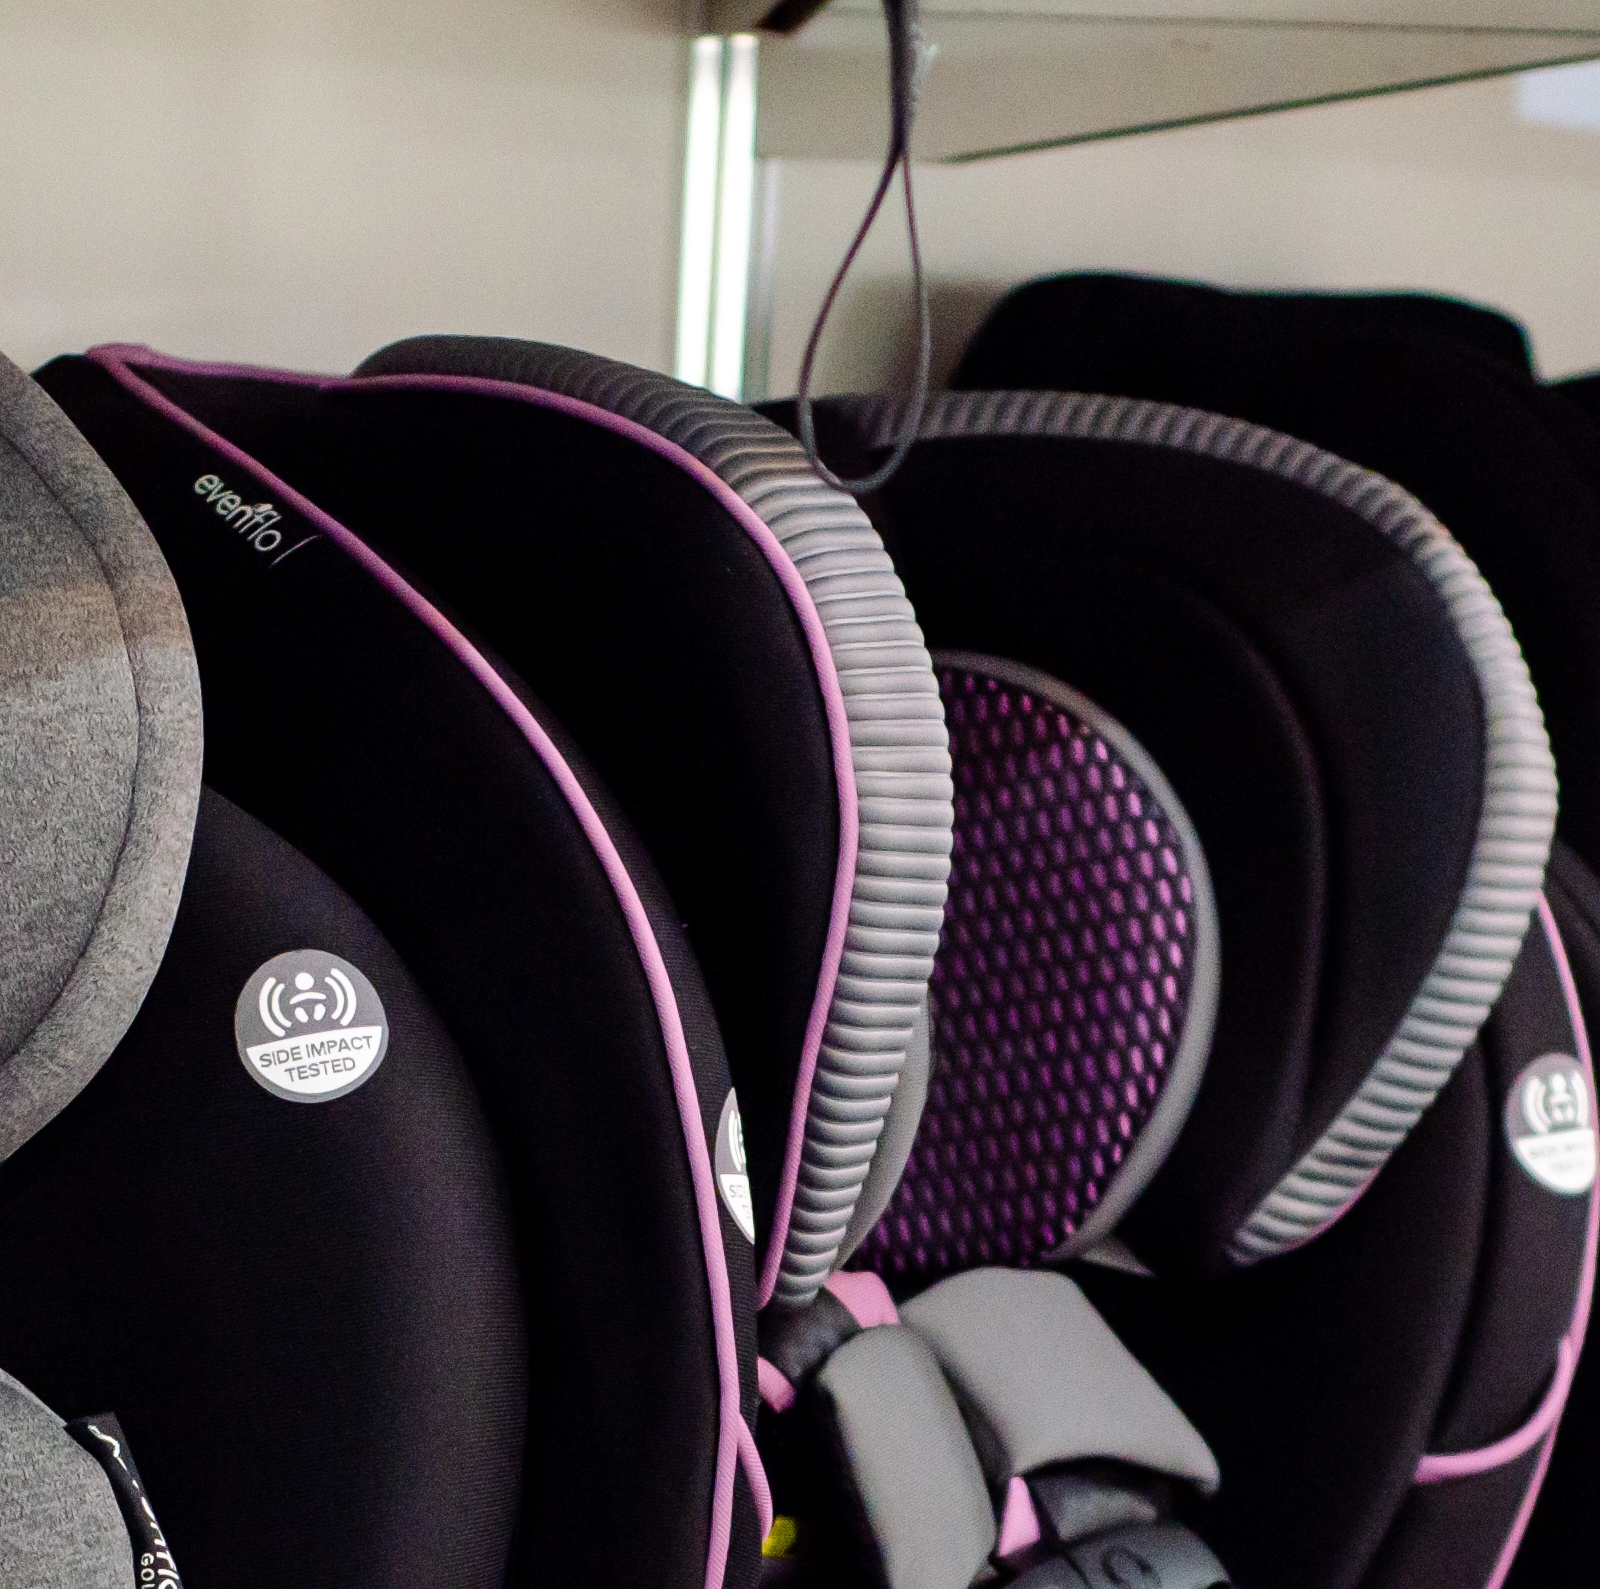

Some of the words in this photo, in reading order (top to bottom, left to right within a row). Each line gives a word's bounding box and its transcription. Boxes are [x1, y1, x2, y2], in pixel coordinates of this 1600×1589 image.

[192, 474, 282, 552] evenflo
[259, 1046, 303, 1069] SIDE
[305, 1035, 373, 1059] IMPACT
[284, 1056, 356, 1083] TESTED
